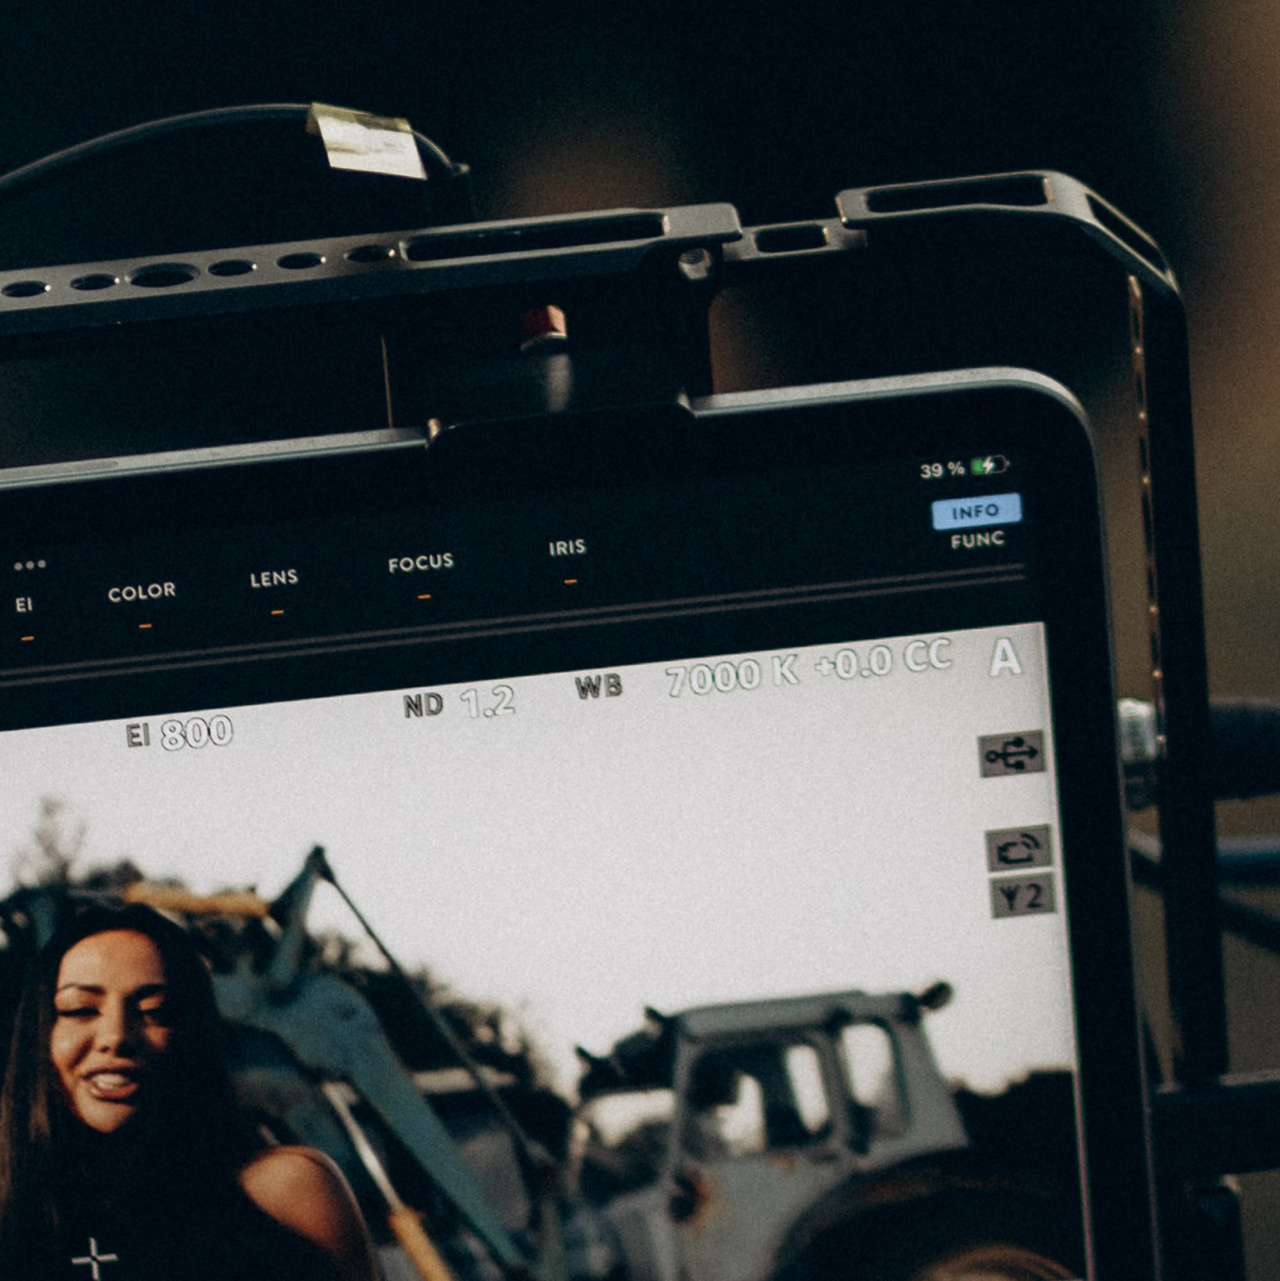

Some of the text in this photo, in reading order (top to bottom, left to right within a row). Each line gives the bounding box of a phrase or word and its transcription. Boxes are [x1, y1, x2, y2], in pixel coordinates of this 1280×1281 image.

[920, 461, 965, 479] 39 %
[952, 503, 999, 521] INFO
[548, 538, 586, 557] IRIS
[951, 530, 1004, 549] FUNC
[387, 552, 453, 573] FOCUS
[250, 568, 298, 588] LENS
[108, 581, 176, 603] COLOR
[16, 596, 33, 613] EI
[664, 637, 953, 699] 7000 K +0.0 CC
[988, 637, 1022, 678] A
[575, 673, 624, 701] WB
[402, 683, 517, 720] ND 1.2
[126, 714, 234, 752] EI 800
